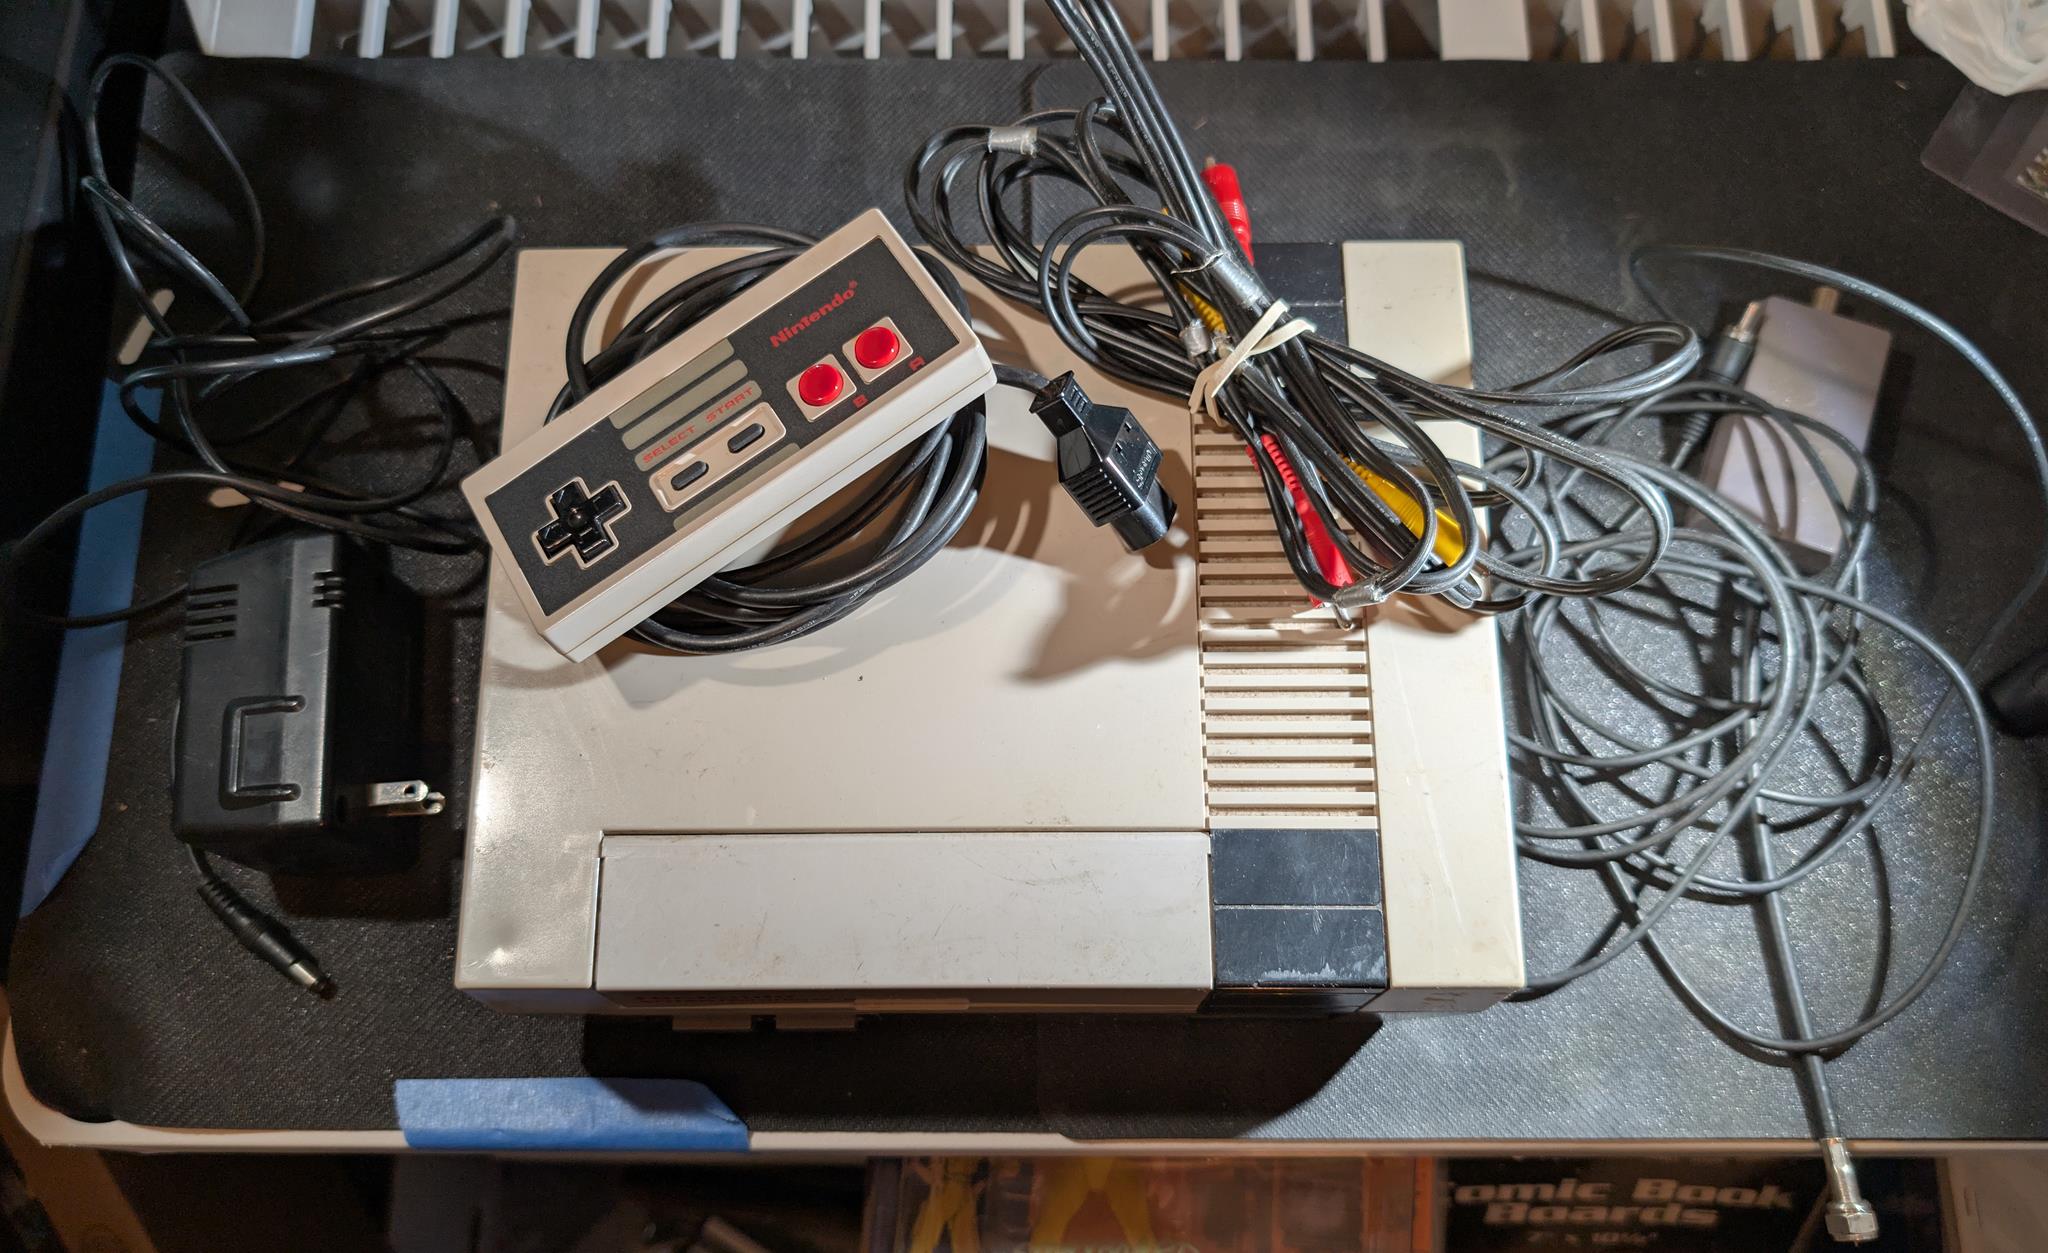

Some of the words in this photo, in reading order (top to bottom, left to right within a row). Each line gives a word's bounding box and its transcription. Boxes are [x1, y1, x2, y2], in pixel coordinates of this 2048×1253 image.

[908, 355, 926, 371] A
[852, 394, 869, 408] B
[642, 424, 696, 464] SELECT
[705, 386, 754, 423] START
[1448, 1178, 1612, 1204] omic
[1631, 1178, 1793, 1207] Book
[1484, 1202, 1720, 1225] Boards
